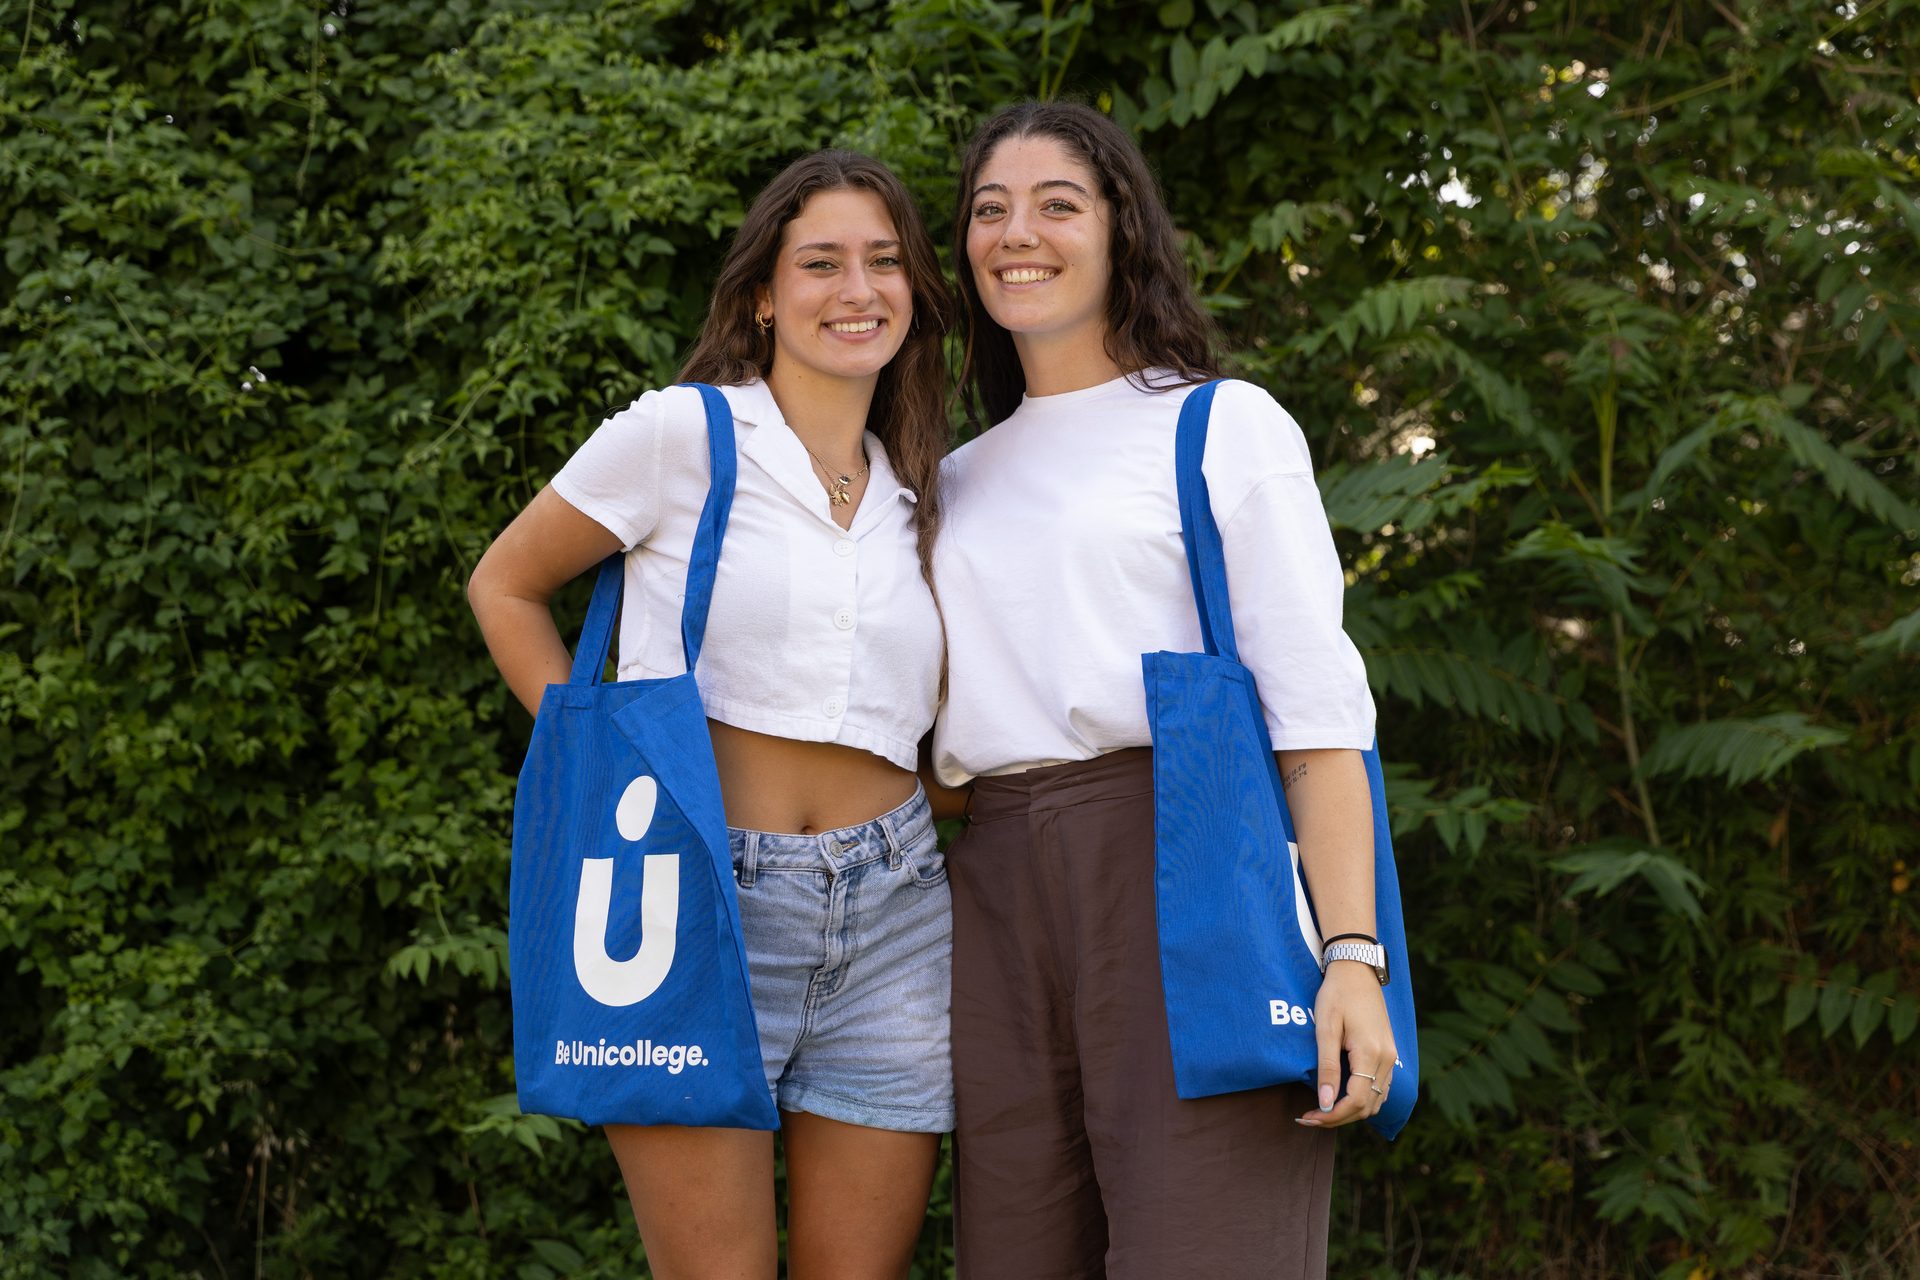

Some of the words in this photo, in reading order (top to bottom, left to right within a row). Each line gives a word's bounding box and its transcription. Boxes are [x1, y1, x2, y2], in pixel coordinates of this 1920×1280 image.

[1269, 999, 1308, 1026] Be
[554, 1040, 571, 1066] Be
[572, 1038, 709, 1075] Unicollege.
